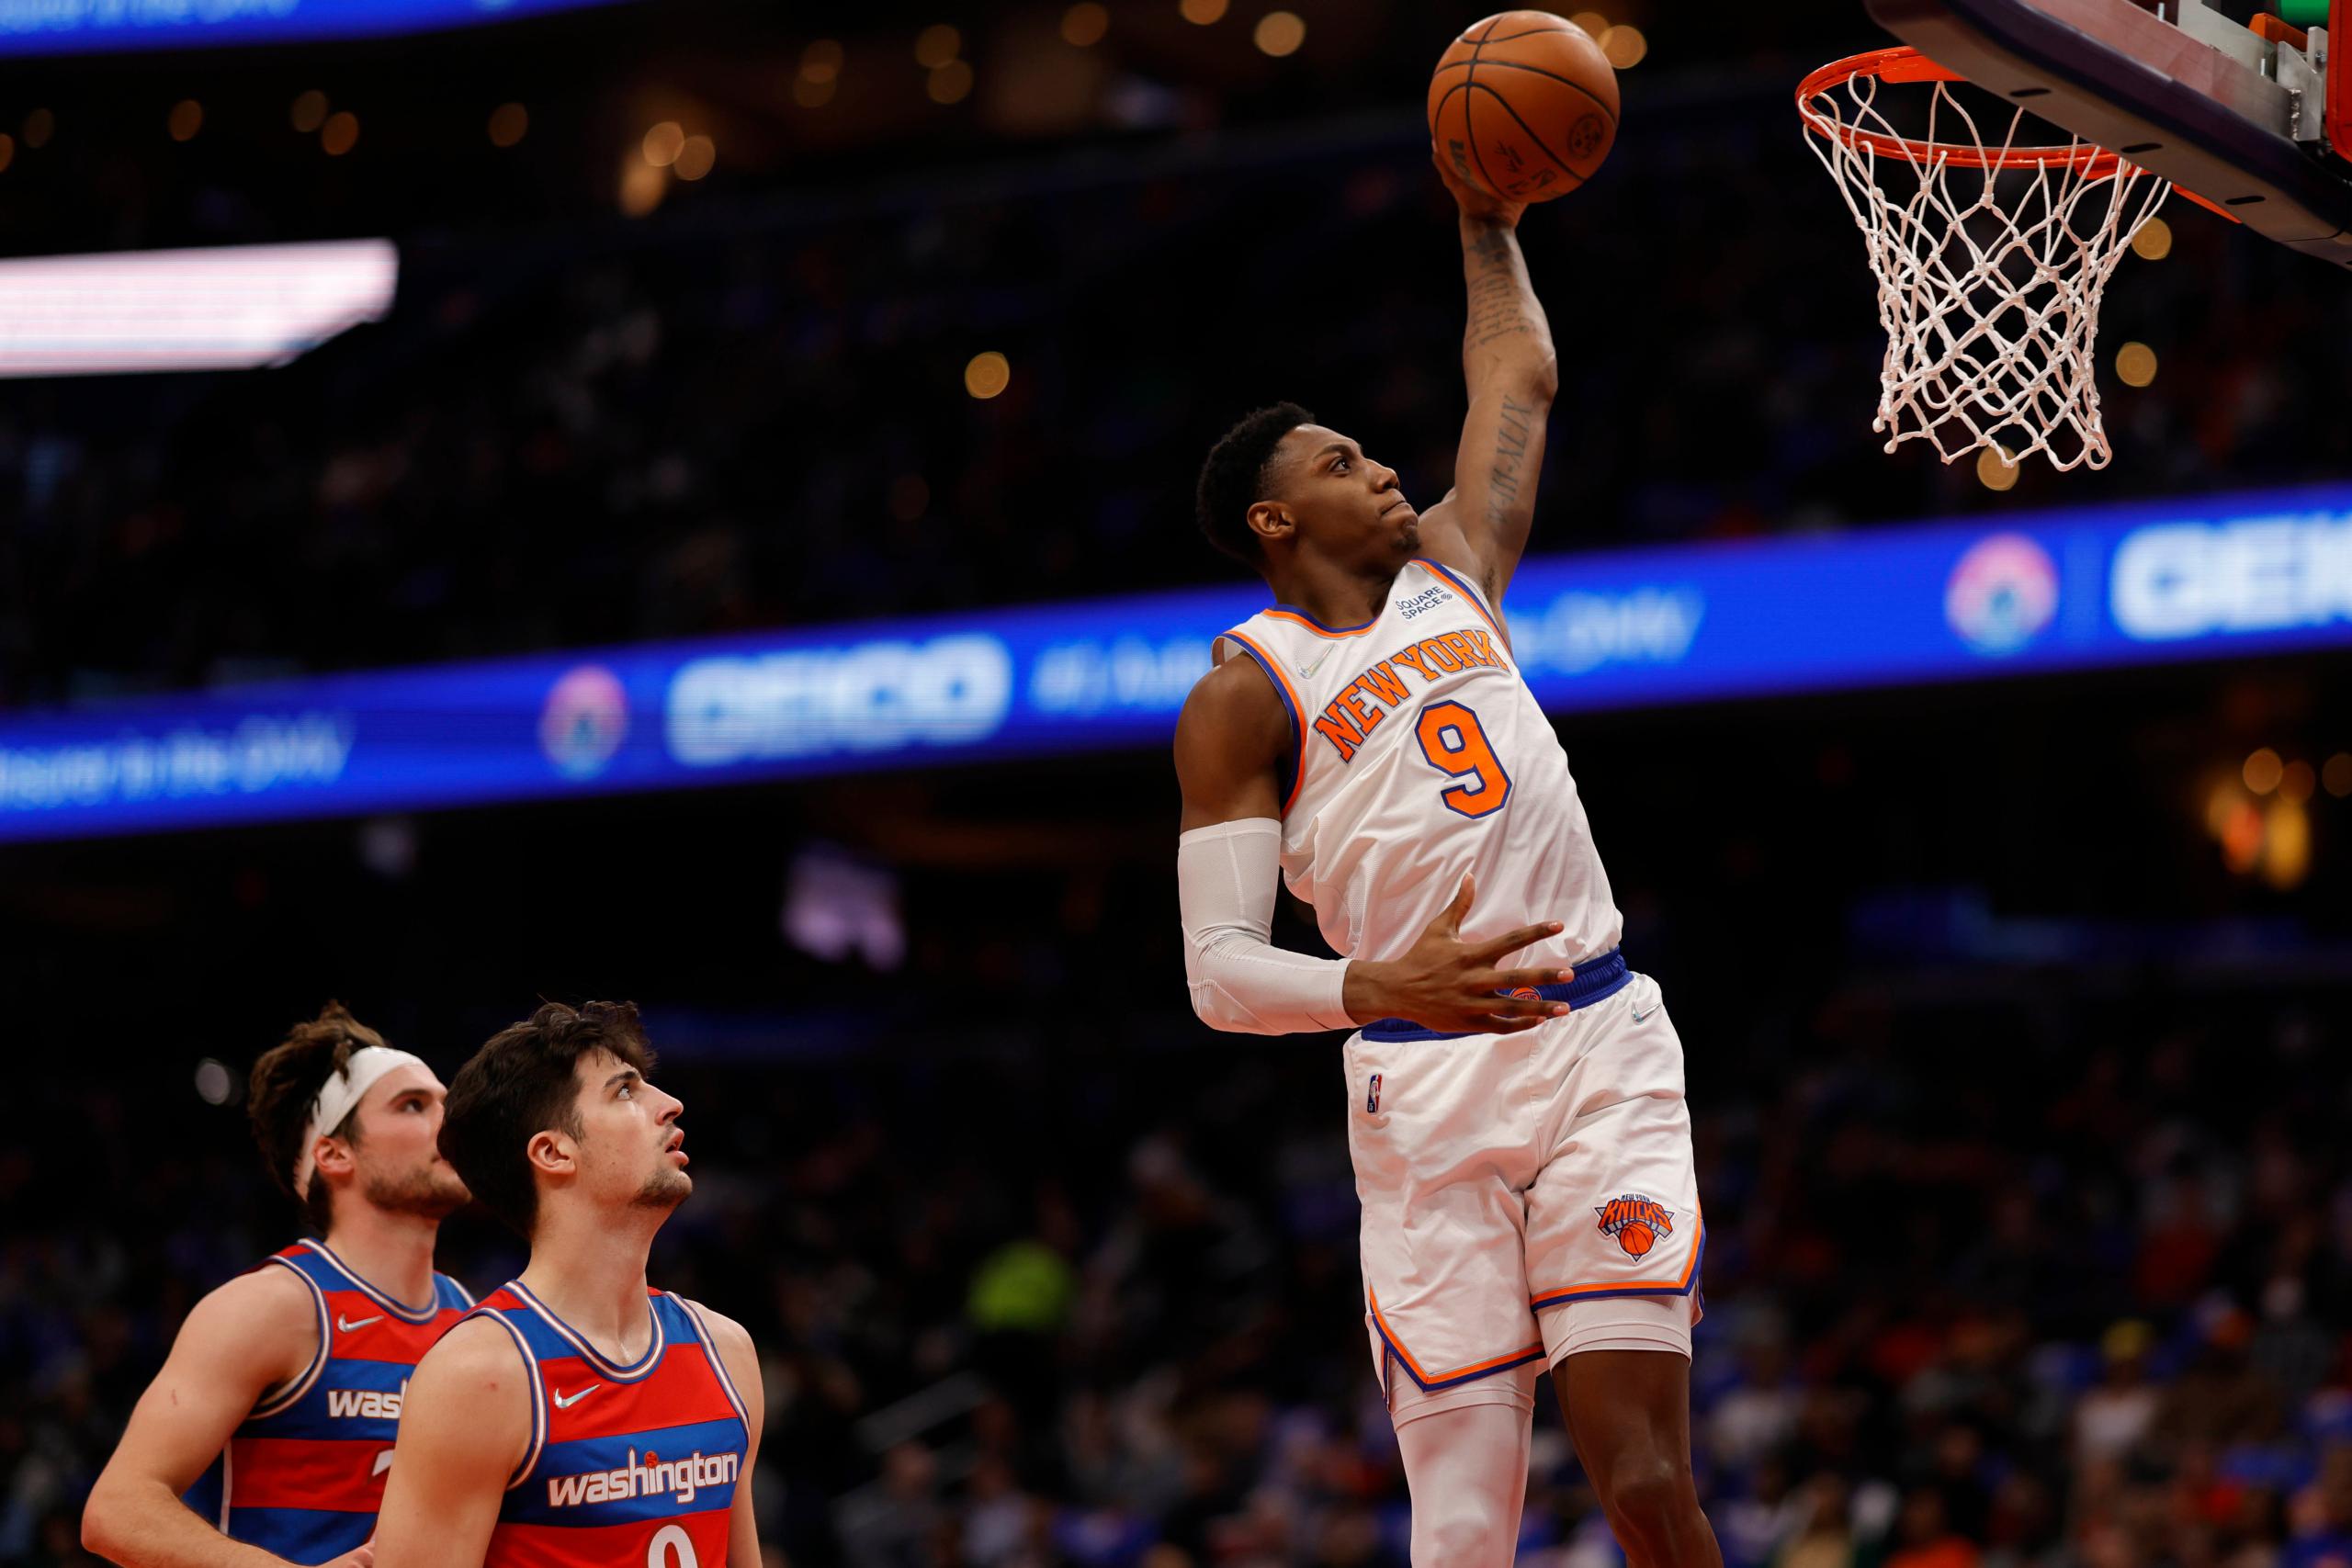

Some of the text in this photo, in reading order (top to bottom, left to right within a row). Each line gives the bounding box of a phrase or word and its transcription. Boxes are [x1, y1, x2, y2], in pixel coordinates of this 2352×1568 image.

[1396, 586, 1443, 610] SQUARE
[1402, 596, 1443, 620] SPACE
[1312, 660, 1412, 764] NEW
[1391, 628, 1513, 682] YORK
[1414, 699, 1512, 819] 9
[1598, 1199, 1673, 1234] KNICKS
[1635, 1193, 1650, 1203] YORK
[328, 1379, 408, 1419] was
[548, 1448, 738, 1506] washington
